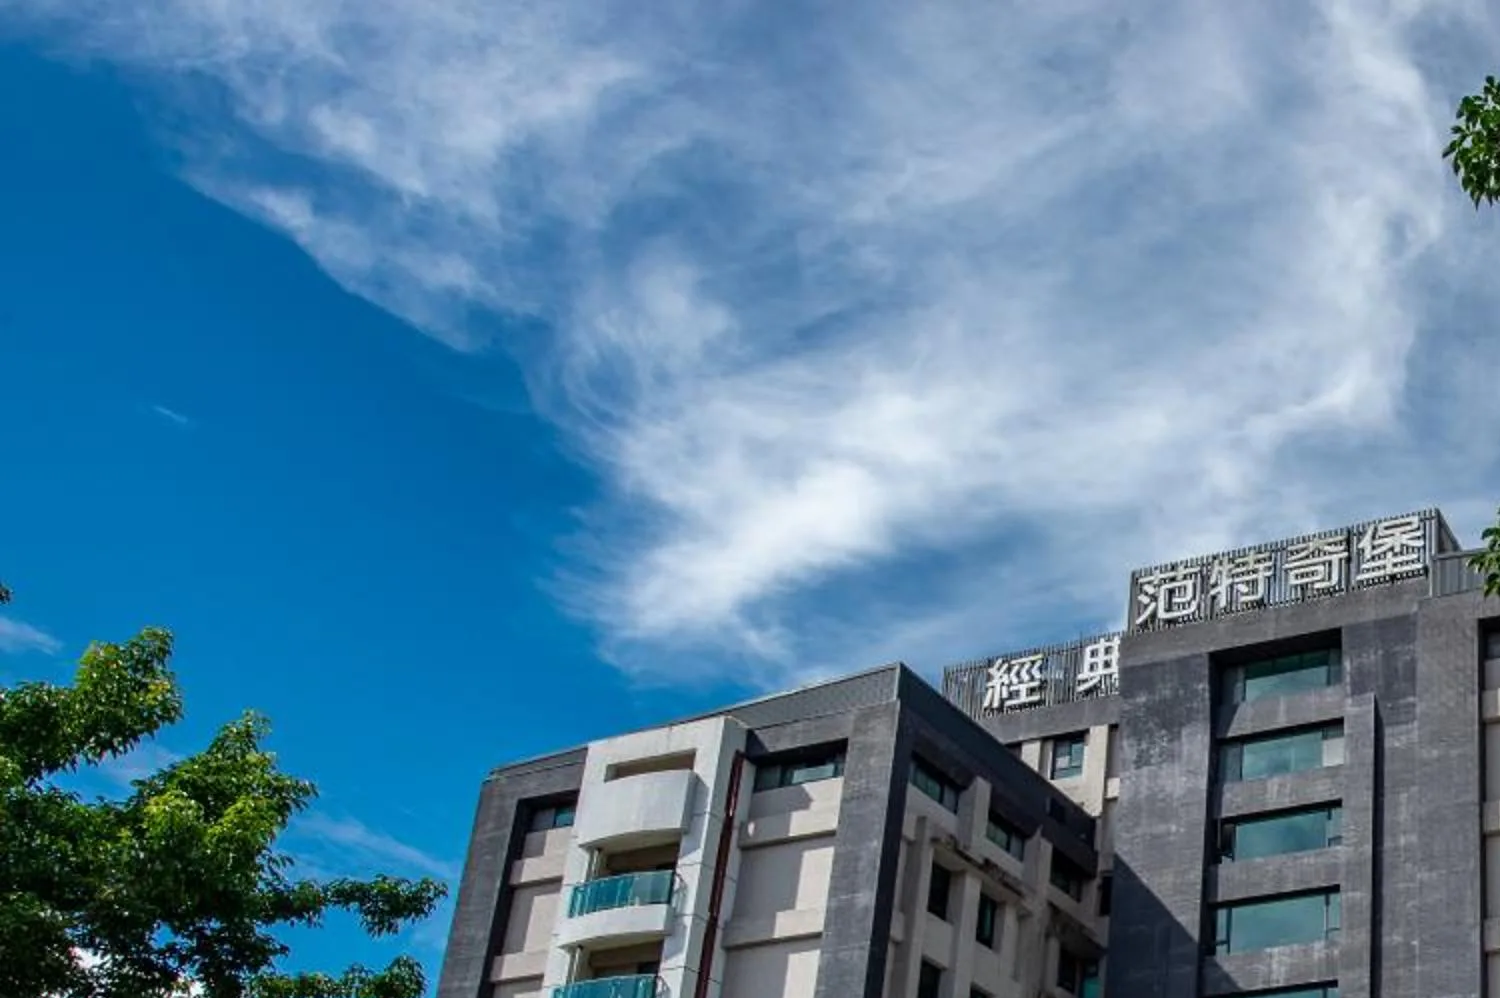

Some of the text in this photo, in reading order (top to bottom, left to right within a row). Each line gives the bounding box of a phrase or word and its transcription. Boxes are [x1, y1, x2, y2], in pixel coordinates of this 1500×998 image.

[1135, 516, 1426, 625] 范特奇堡
[982, 635, 1120, 708] 經典
